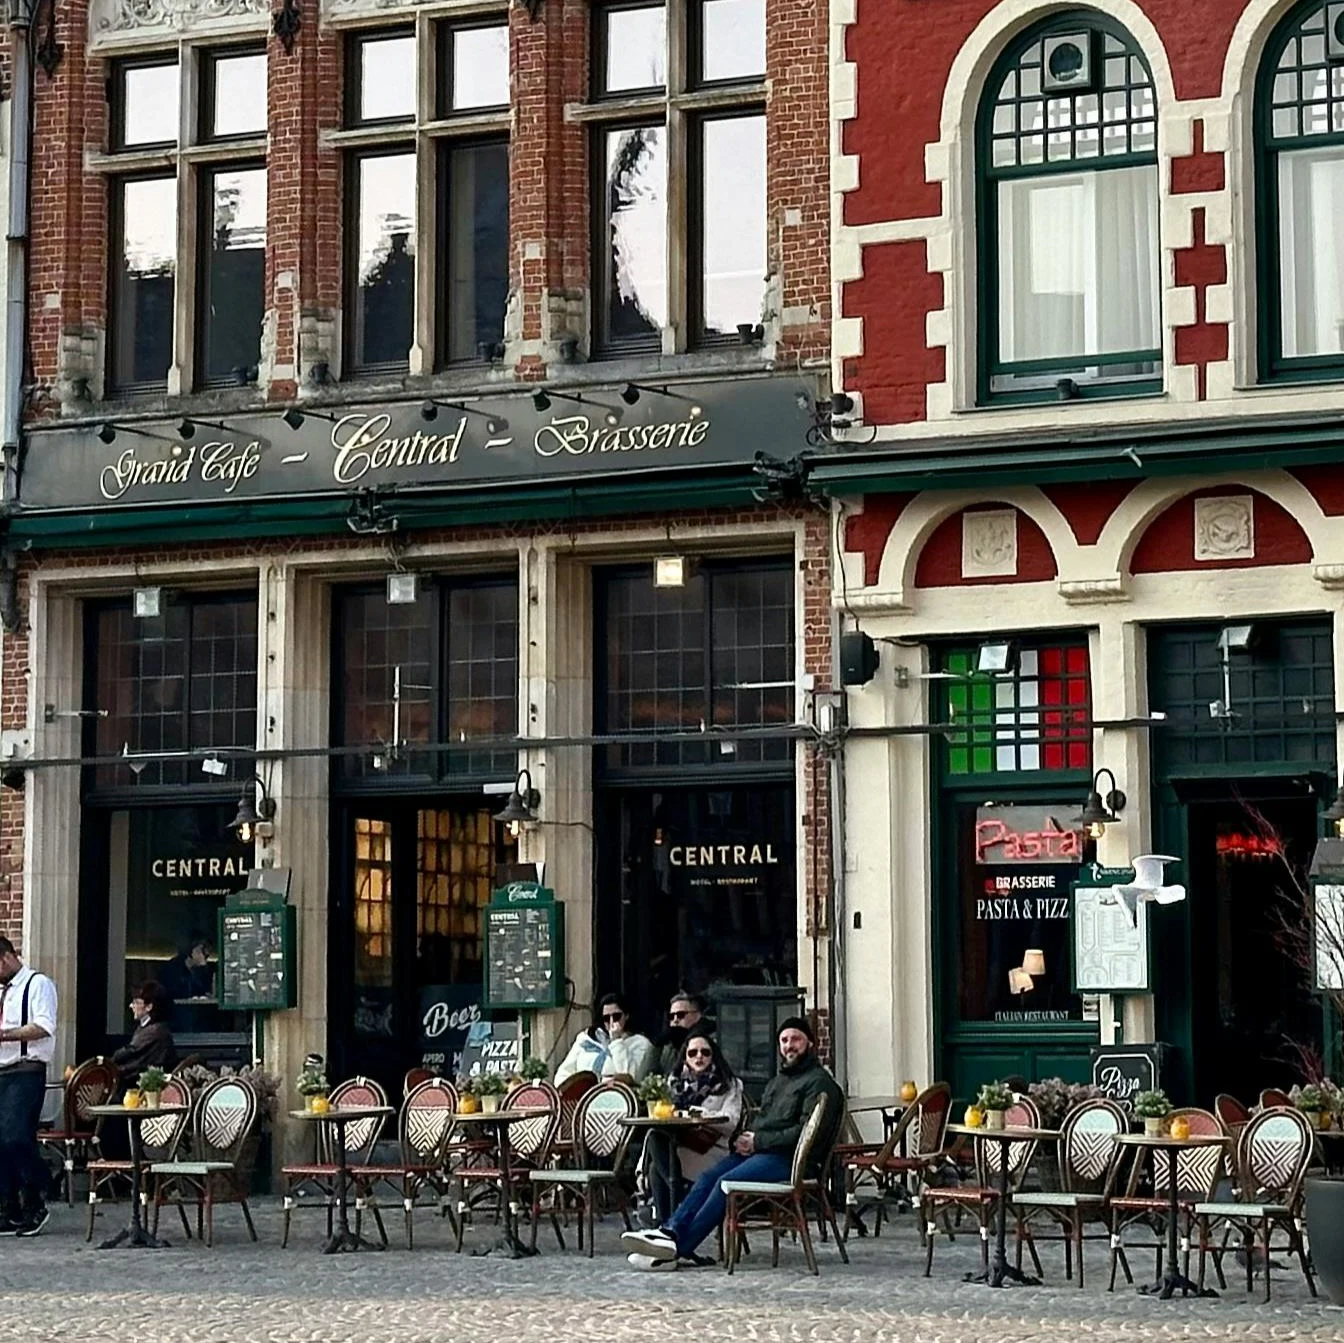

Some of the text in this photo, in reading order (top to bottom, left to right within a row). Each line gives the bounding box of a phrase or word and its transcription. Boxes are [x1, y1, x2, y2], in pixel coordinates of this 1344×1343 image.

[99, 446, 196, 500] Grand
[330, 413, 467, 484] Central
[534, 415, 710, 457] Brasserie
[975, 814, 1078, 861] Pasta
[669, 843, 778, 866] CENTRAL
[151, 856, 250, 878] CENTRAL
[995, 875, 1056, 890] BRASSERIE
[975, 897, 1070, 921] PASTA & PIZZ
[481, 1039, 519, 1057] PIZZA
[469, 1061, 481, 1077] &
[1099, 1066, 1140, 1099] Pizza
